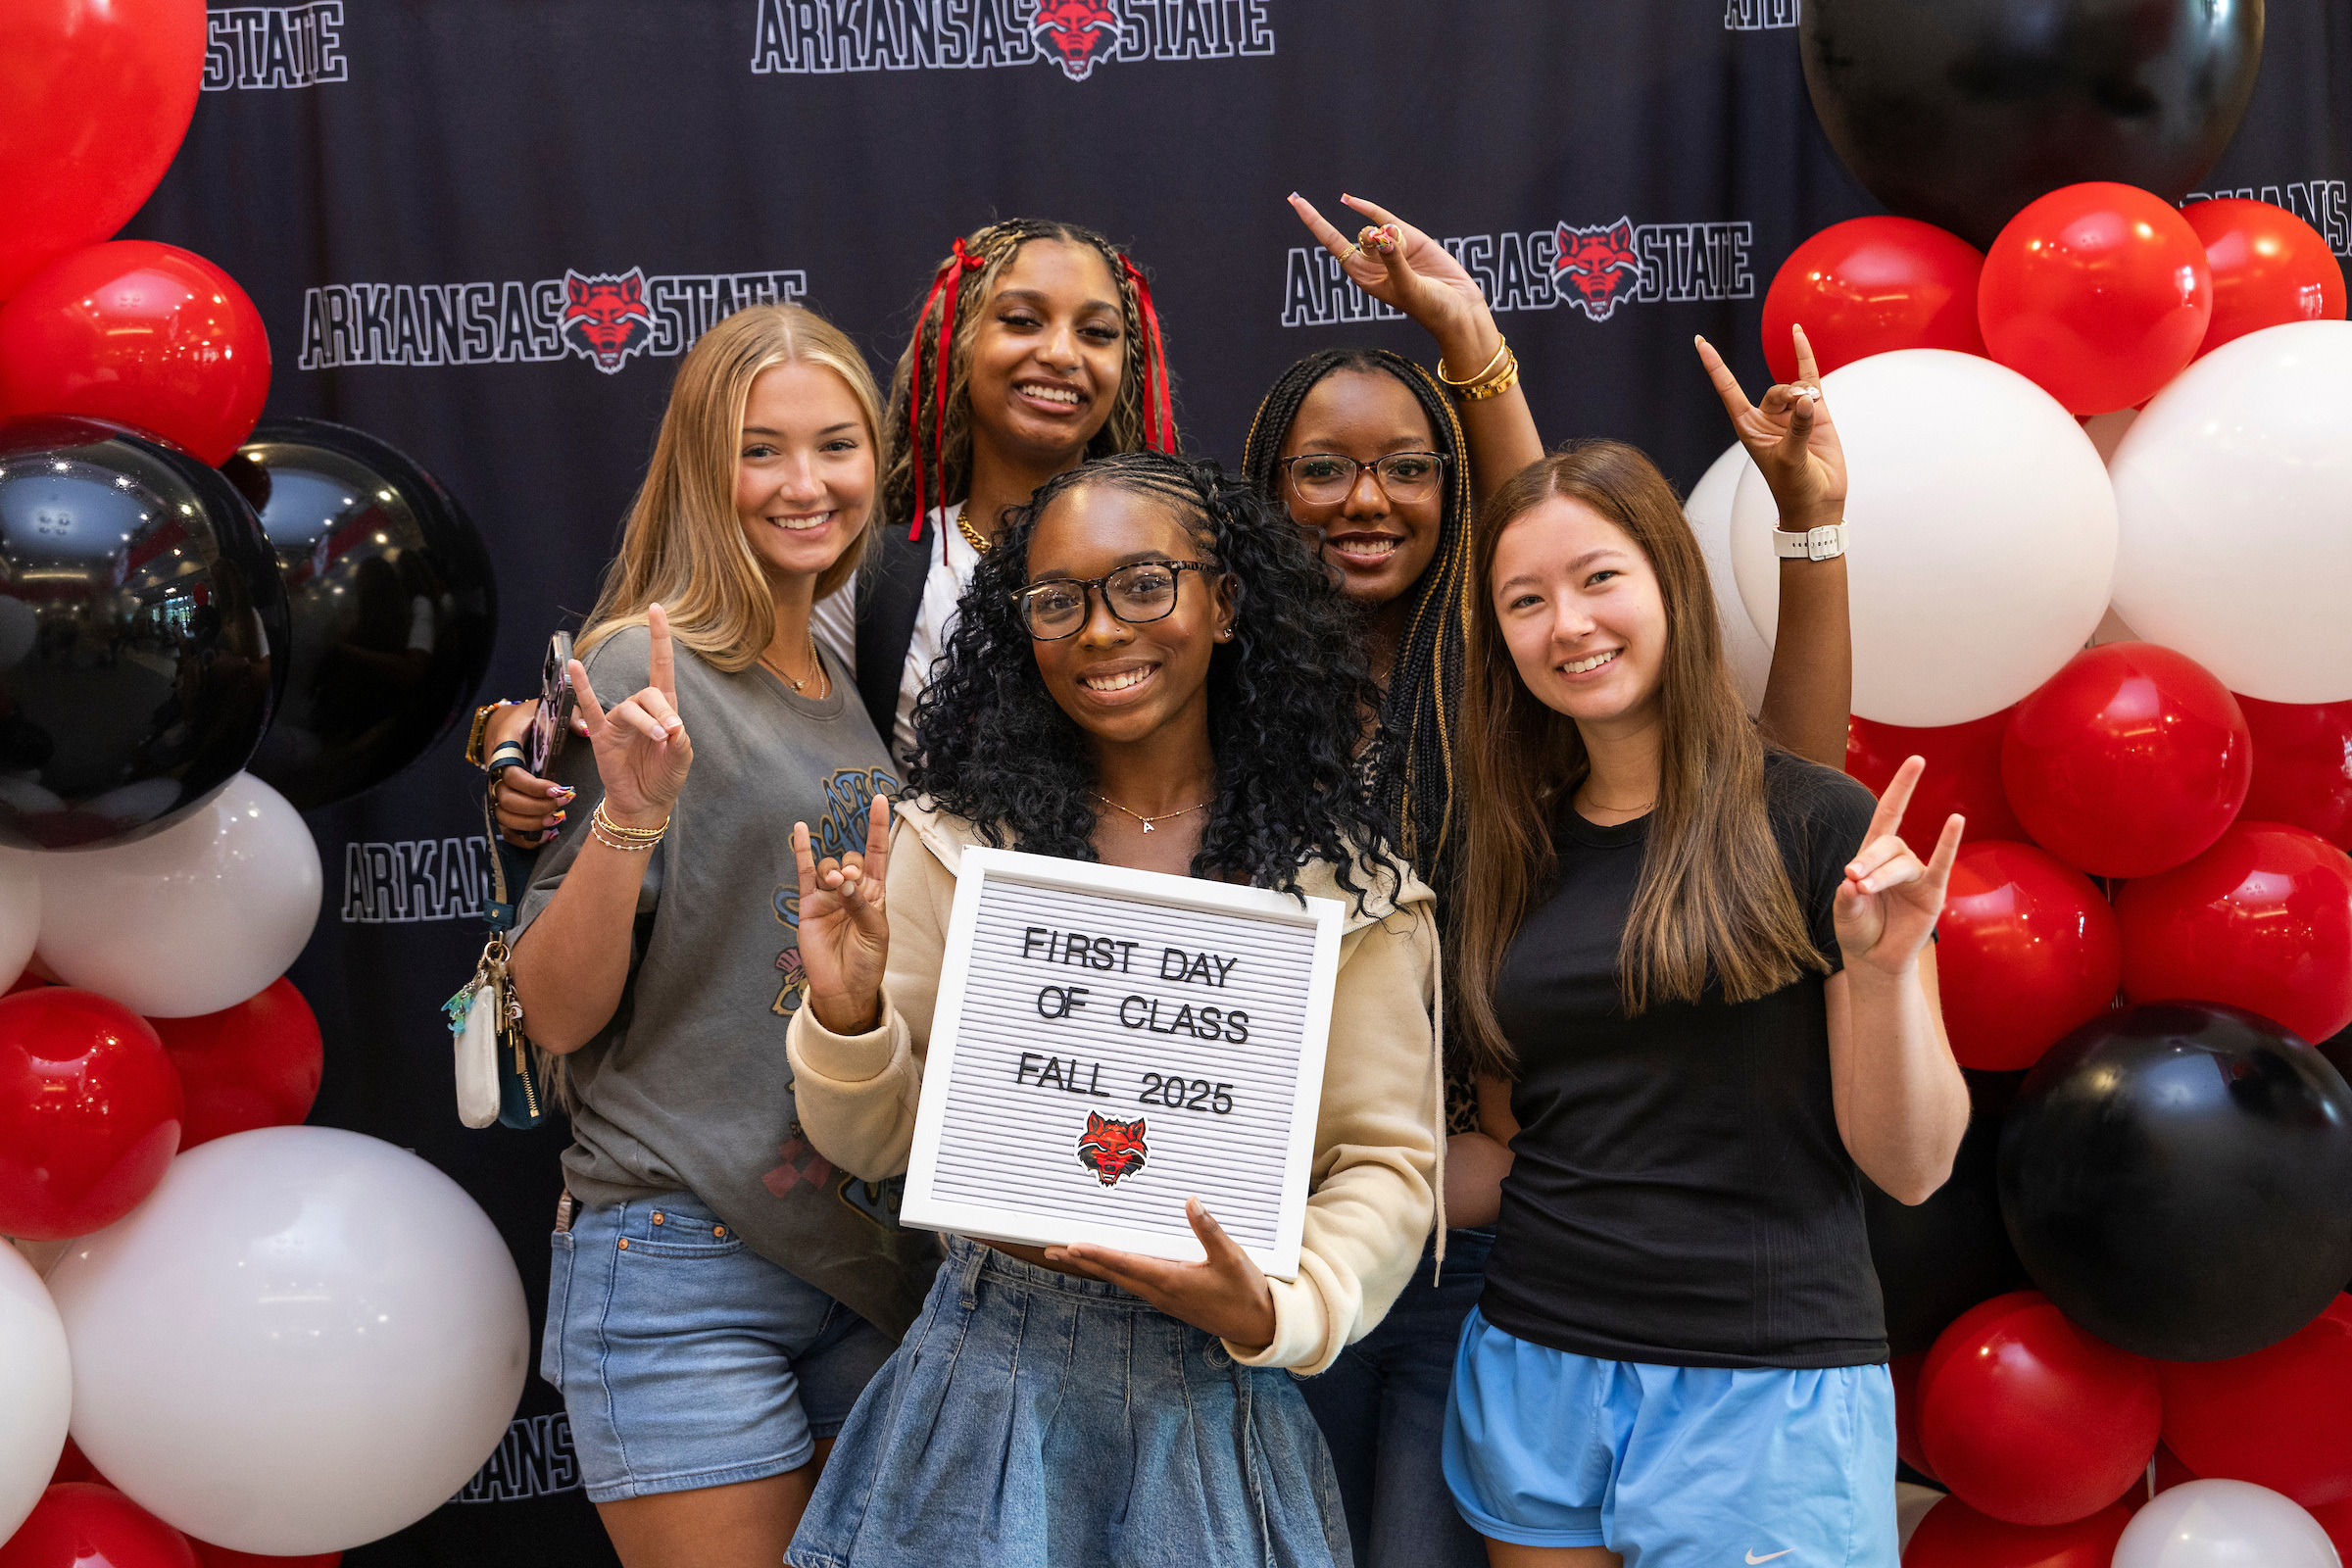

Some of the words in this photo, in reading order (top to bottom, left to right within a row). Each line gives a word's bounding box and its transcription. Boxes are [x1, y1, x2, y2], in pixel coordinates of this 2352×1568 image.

[200, 0, 349, 91] STATE
[751, 0, 1041, 74] ARKANSAS
[1117, 0, 1275, 62] STATE
[1281, 231, 1559, 327] ARSAS
[1637, 221, 1756, 302] STATE
[298, 280, 568, 370] ARKANSAS
[1022, 926, 1139, 974] FIRST
[1160, 947, 1238, 988] DAY
[1037, 985, 1090, 1019] OF
[1118, 995, 1250, 1045] CLASS
[1016, 1052, 1110, 1098] FALL
[1139, 1071, 1235, 1115] 2025
